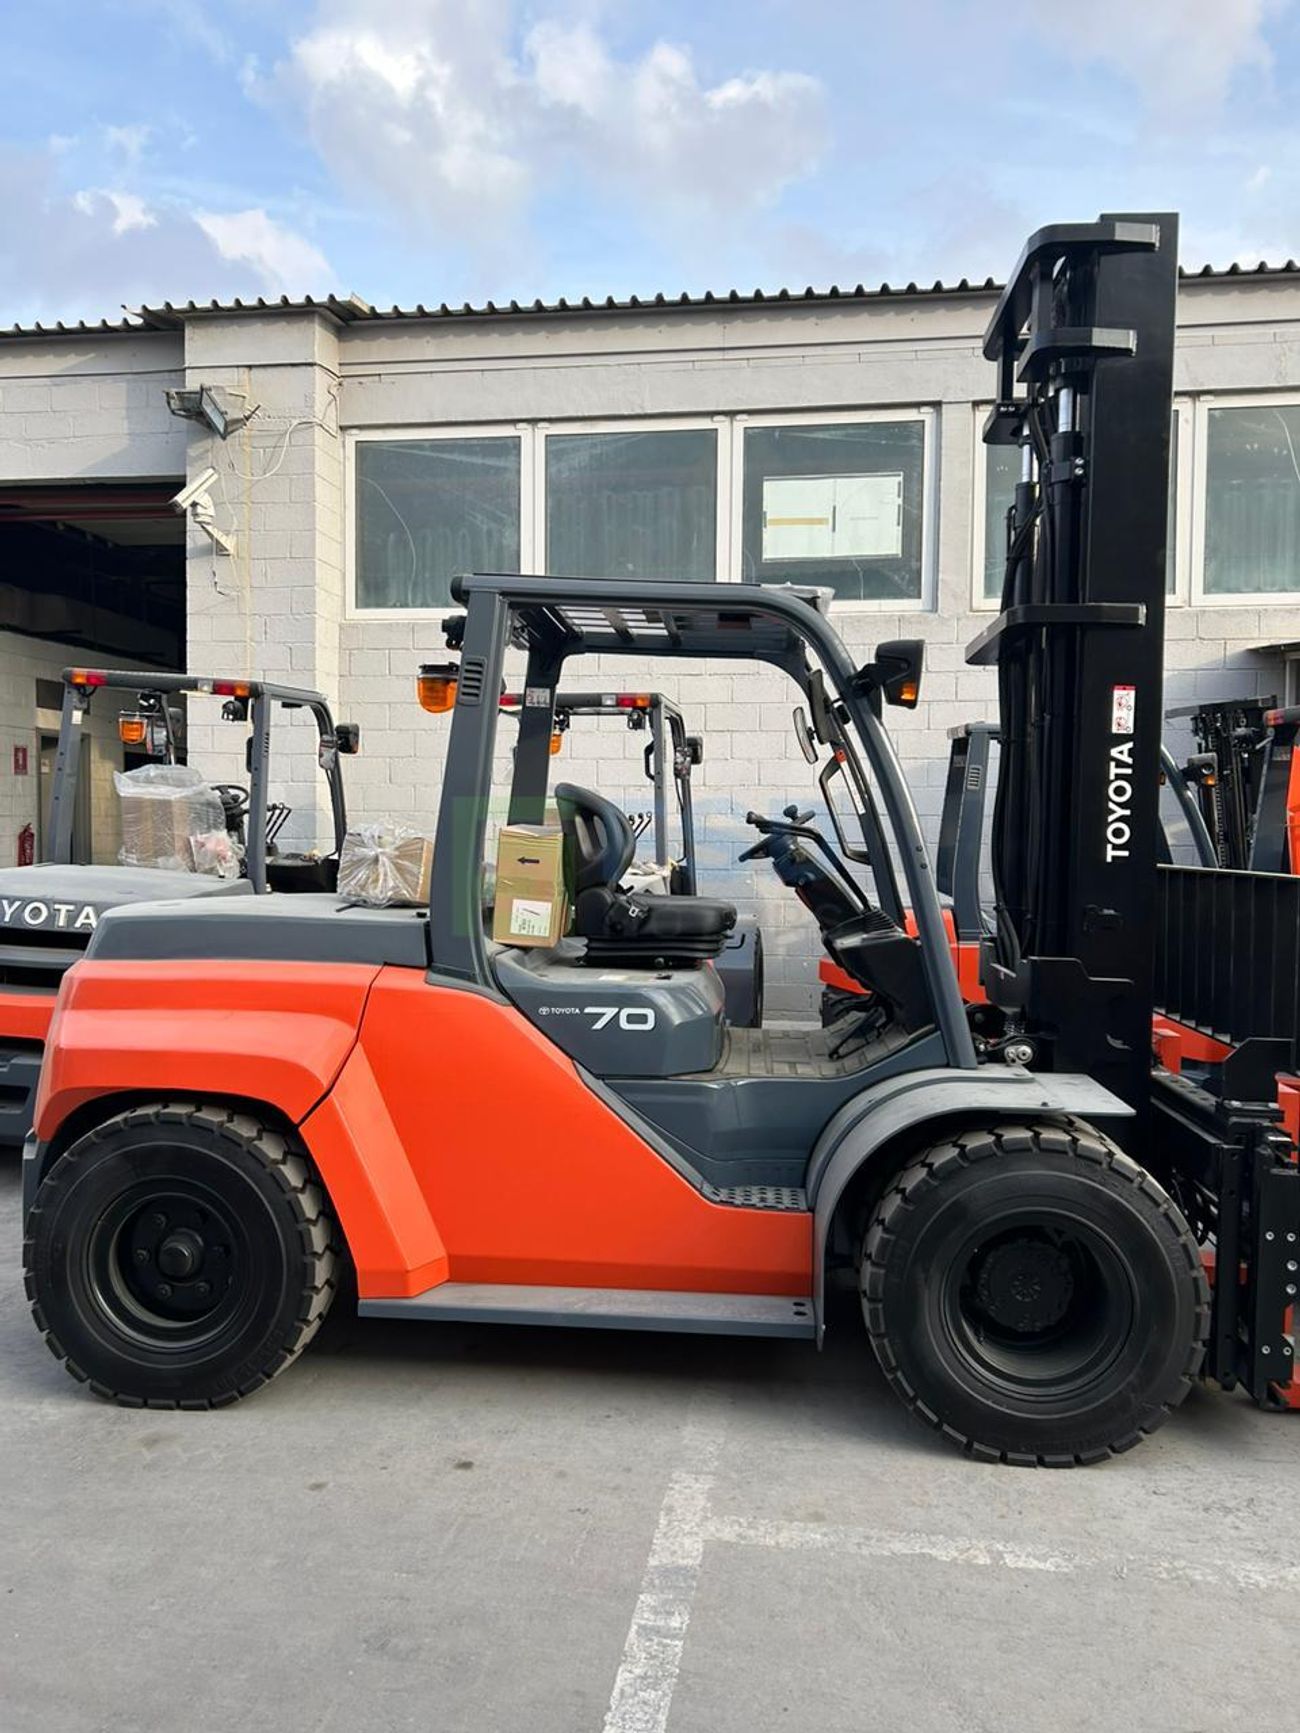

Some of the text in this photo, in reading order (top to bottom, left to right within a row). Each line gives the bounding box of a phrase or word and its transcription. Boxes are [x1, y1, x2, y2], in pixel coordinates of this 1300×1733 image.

[1106, 742, 1134, 862] TOYOTA
[1, 899, 98, 928] YOTA
[551, 1006, 655, 1031] TOYOTA 70
